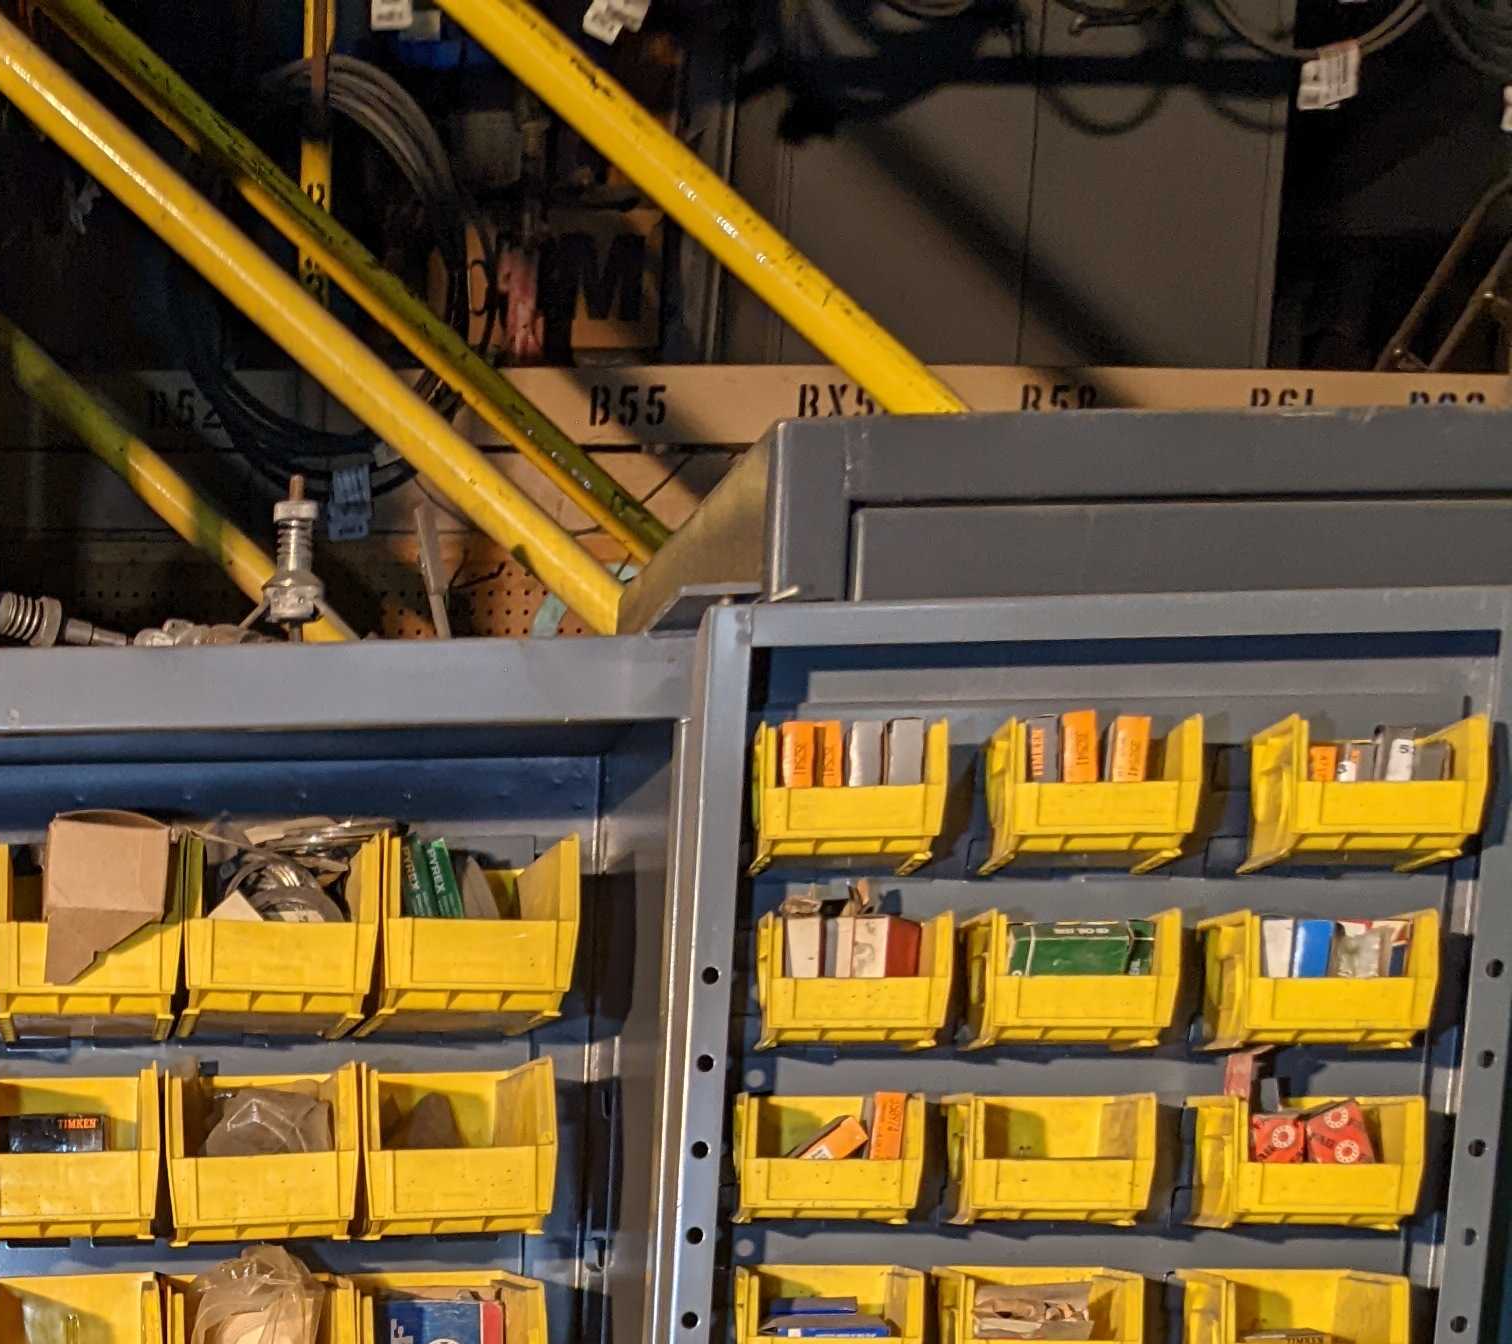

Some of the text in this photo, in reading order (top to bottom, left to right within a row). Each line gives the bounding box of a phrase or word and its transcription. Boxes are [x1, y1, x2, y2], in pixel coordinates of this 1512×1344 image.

[589, 385, 667, 427] B55
[798, 383, 888, 418] BX5
[427, 847, 446, 894] PYREX
[57, 1118, 98, 1130] TIMKEN
